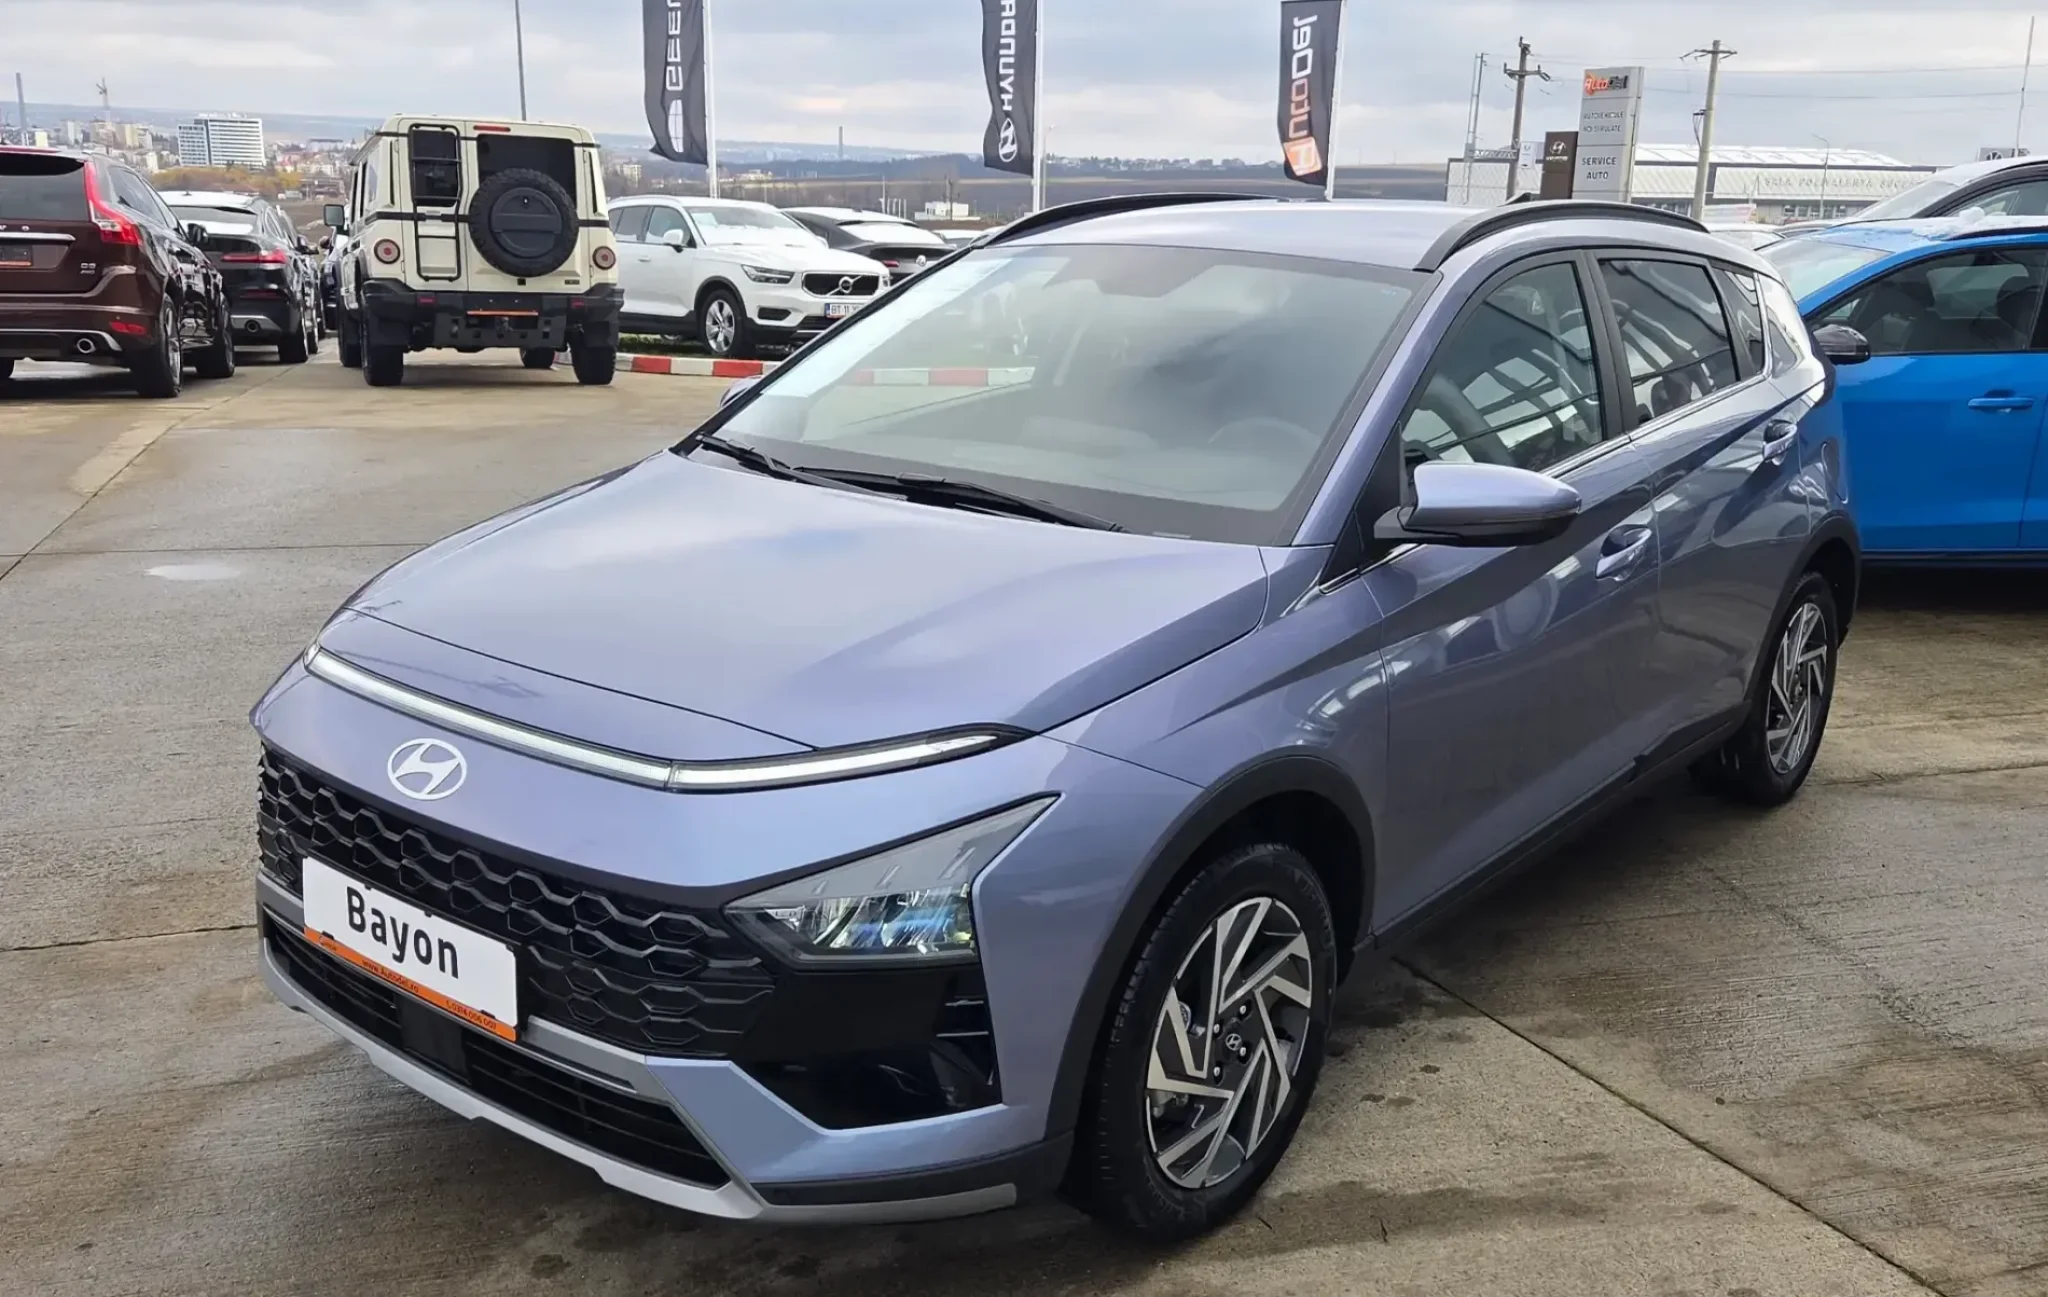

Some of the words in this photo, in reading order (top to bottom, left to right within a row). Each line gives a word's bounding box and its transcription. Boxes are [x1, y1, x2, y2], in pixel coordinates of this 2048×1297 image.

[1581, 157, 1617, 166] SERVICE
[1586, 171, 1609, 180] AUTO
[346, 886, 459, 980] Bayon
